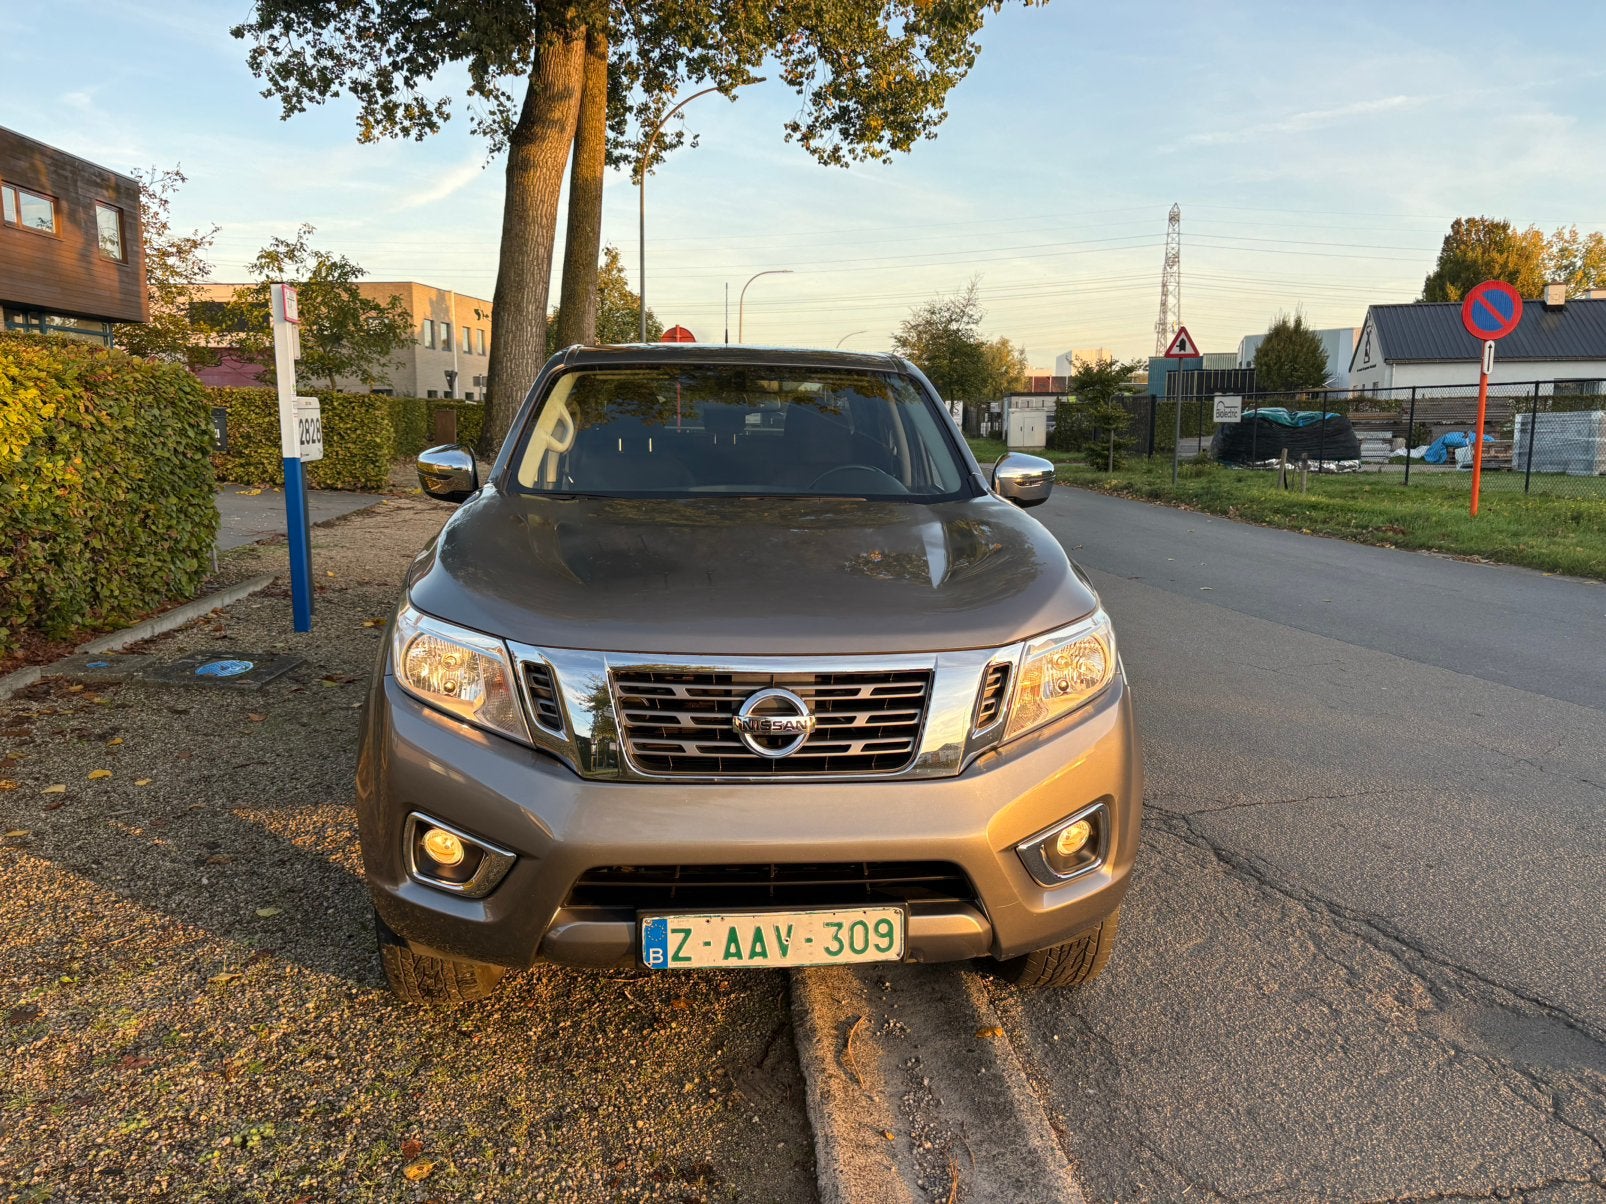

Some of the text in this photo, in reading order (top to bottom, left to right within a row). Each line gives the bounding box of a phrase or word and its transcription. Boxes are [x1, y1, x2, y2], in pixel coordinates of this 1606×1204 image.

[299, 417, 321, 445] 2828
[742, 720, 807, 732] NISSAN
[670, 918, 895, 963] Z-AAV-309
[650, 948, 664, 963] B
